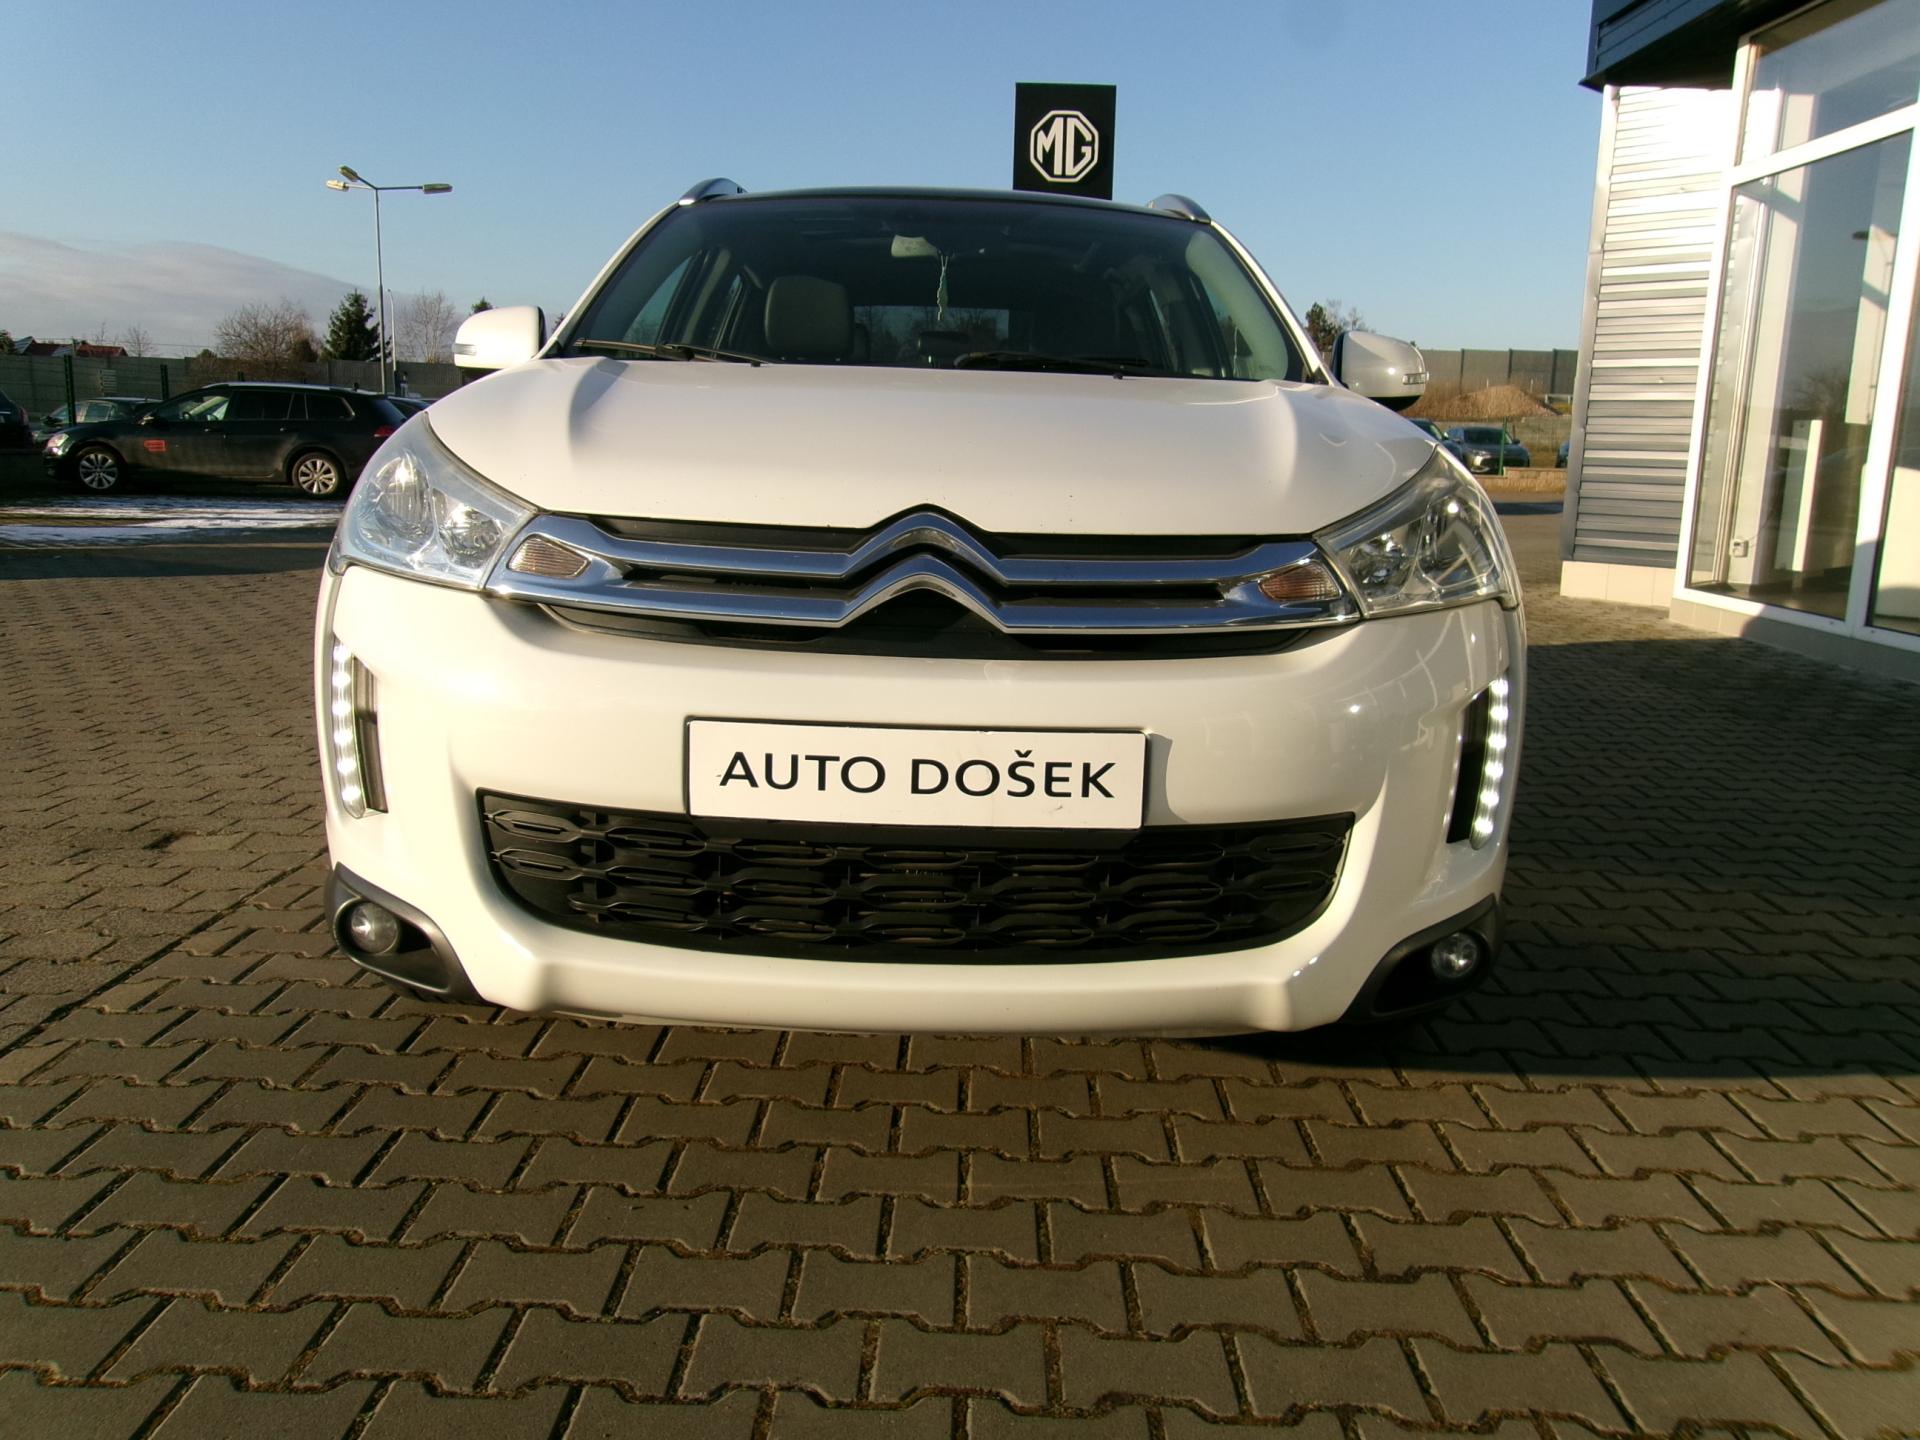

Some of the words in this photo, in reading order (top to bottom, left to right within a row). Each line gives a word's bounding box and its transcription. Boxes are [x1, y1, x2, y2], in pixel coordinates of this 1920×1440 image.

[1036, 116, 1093, 176] MG
[719, 751, 886, 794] AUTO
[910, 749, 1116, 798] DOŠEK
